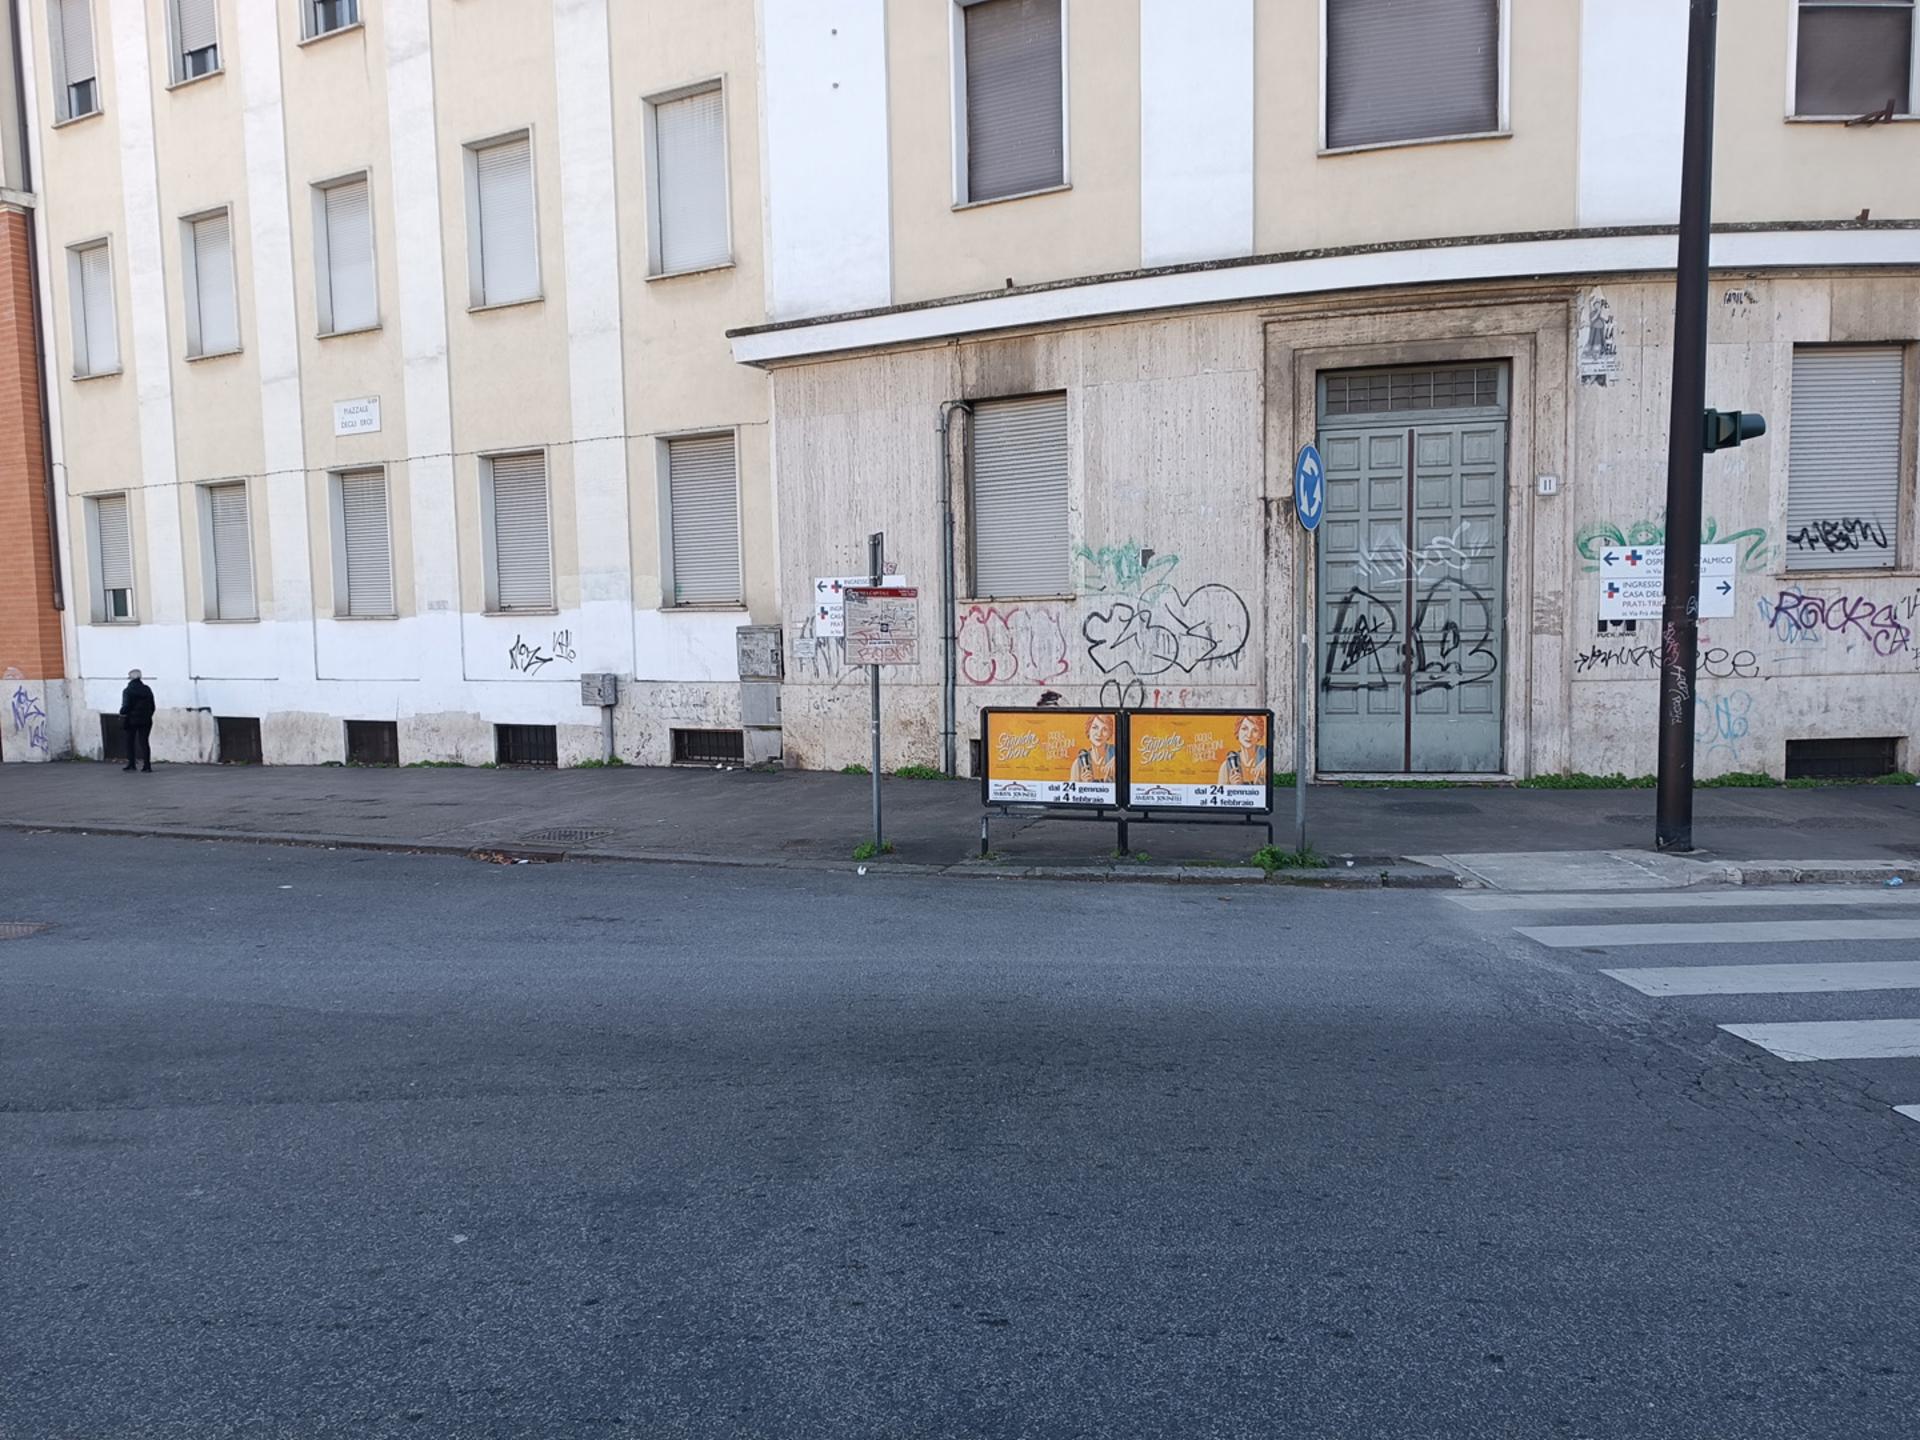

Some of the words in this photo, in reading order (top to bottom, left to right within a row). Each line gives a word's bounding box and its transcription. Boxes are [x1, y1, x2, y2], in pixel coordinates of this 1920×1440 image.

[343, 405, 369, 415] PIAZZALE
[341, 420, 358, 428] DEGLI
[359, 418, 374, 427] EROI
[1700, 556, 1733, 564] ALMICO
[1622, 580, 1662, 588] INGRESSO
[1622, 590, 1645, 598] CASA
[1048, 784, 1061, 792] dal
[1063, 782, 1076, 792] 24
[1078, 785, 1110, 794] gennaio
[1194, 787, 1208, 795] dal
[1210, 784, 1225, 795] 24
[1227, 788, 1260, 797] gennaio
[1062, 792, 1070, 802] 4
[1072, 795, 1105, 803] febbraio
[1200, 798, 1208, 806] al
[1210, 795, 1218, 806] 4
[1220, 798, 1255, 806] febbraio
